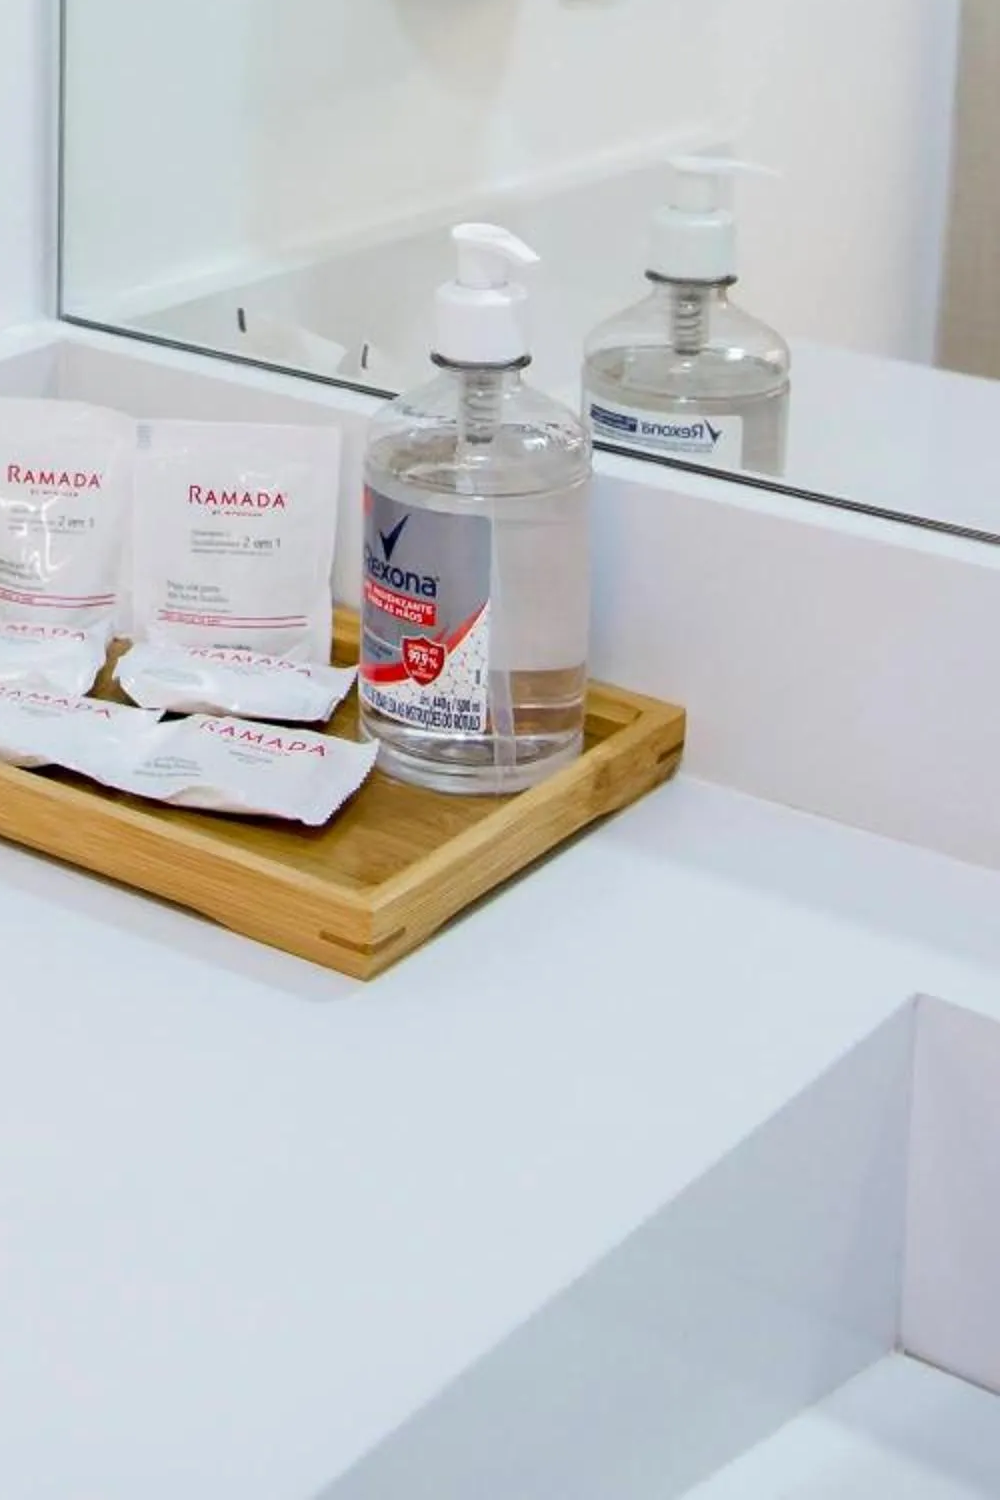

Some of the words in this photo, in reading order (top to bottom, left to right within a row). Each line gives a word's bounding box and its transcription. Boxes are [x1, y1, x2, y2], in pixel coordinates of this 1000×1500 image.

[7, 464, 101, 489] RAMADA
[188, 484, 285, 509] RAMADA
[199, 719, 326, 757] RAMADA
